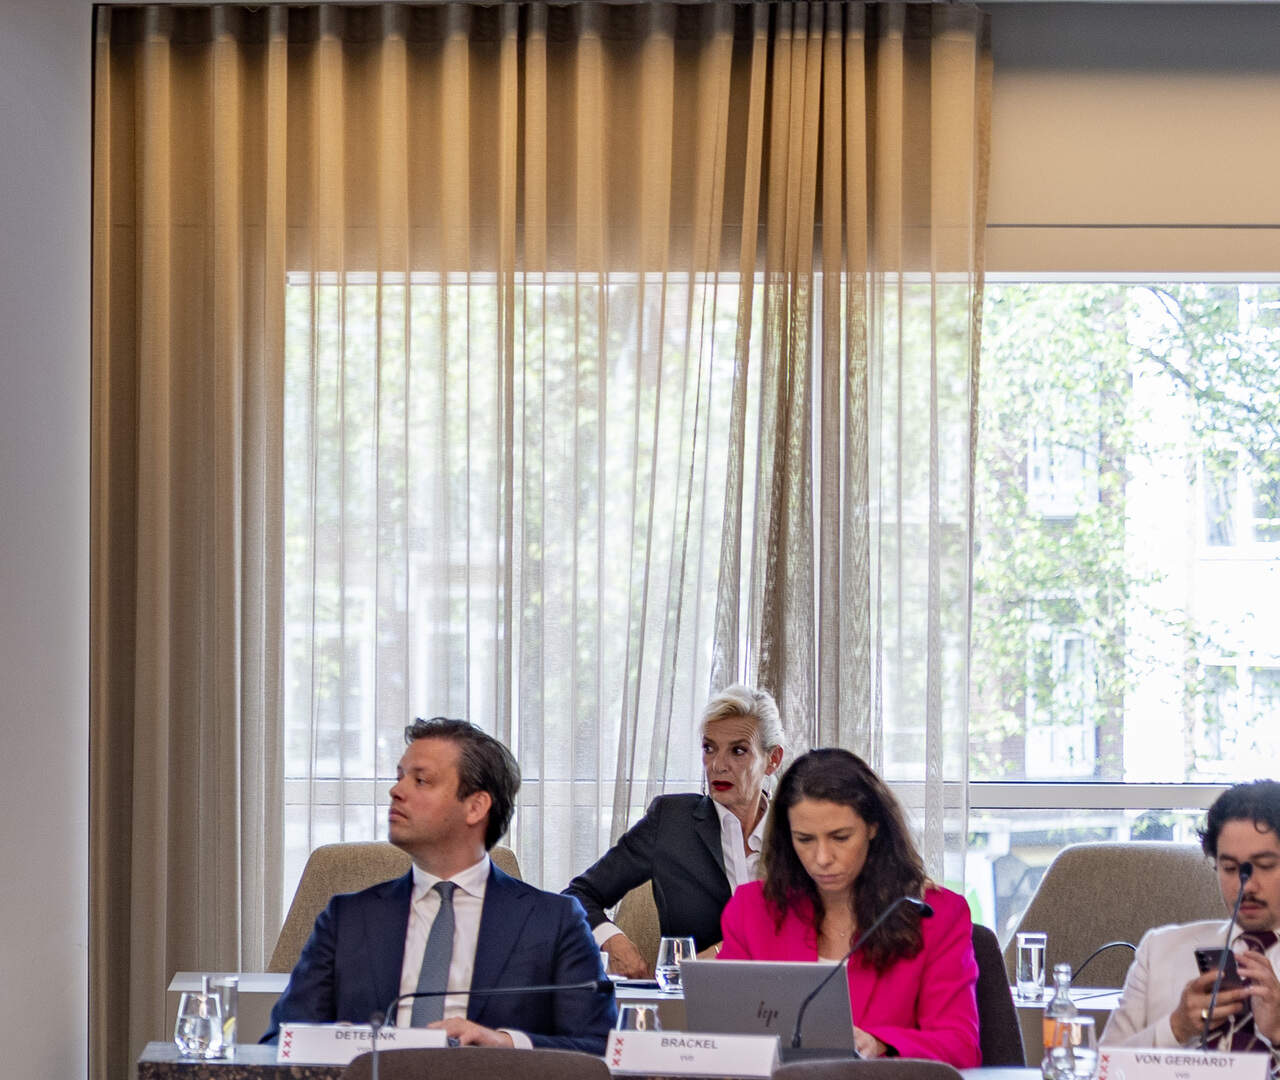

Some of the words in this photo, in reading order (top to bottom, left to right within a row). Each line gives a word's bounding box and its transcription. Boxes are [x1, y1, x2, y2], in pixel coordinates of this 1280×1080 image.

[660, 1037, 718, 1049] BRACKEL
[1134, 1054, 1161, 1065] VON
[1165, 1055, 1236, 1068] GERHARDT
